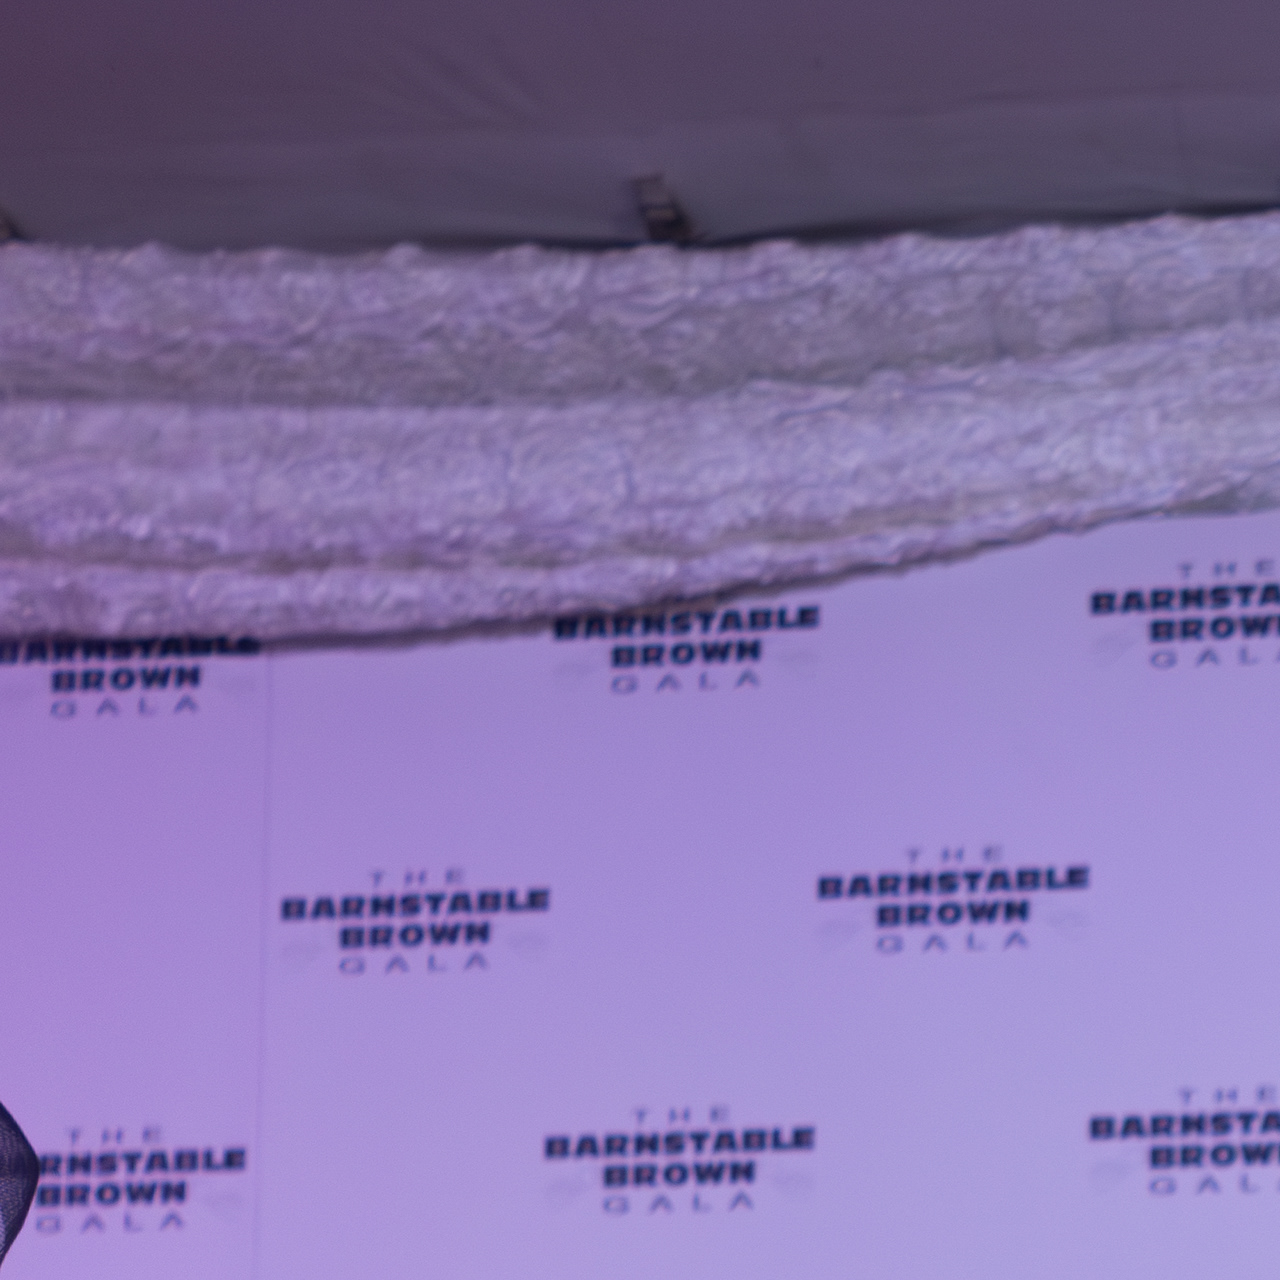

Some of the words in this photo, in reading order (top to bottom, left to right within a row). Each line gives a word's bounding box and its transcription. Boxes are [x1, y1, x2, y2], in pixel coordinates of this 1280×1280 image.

[1177, 558, 1275, 577] THE
[553, 605, 820, 641] BARNSTABLE
[610, 639, 762, 668] BROWN
[51, 665, 201, 693] BROWN
[610, 669, 761, 694] GALA
[50, 696, 198, 719] GALA
[907, 845, 1002, 863] THE
[370, 868, 464, 887] THE
[816, 864, 1091, 901] BARNSTABLE
[280, 887, 551, 922] BARNSTABLE
[876, 899, 1030, 928] BROWN
[339, 921, 491, 949] BROWN
[875, 930, 1029, 955] GALA
[338, 952, 488, 975] GALA
[1178, 1085, 1276, 1104] THE
[634, 1105, 729, 1124] THE
[68, 1126, 162, 1144] THE
[543, 1126, 816, 1160] BARNSTABLE
[40, 1148, 246, 1177] RNSTABLE
[602, 1160, 756, 1188] BROWN
[37, 1179, 187, 1207] BROWN
[601, 1191, 755, 1214] GALA
[35, 1211, 184, 1234] GALA
